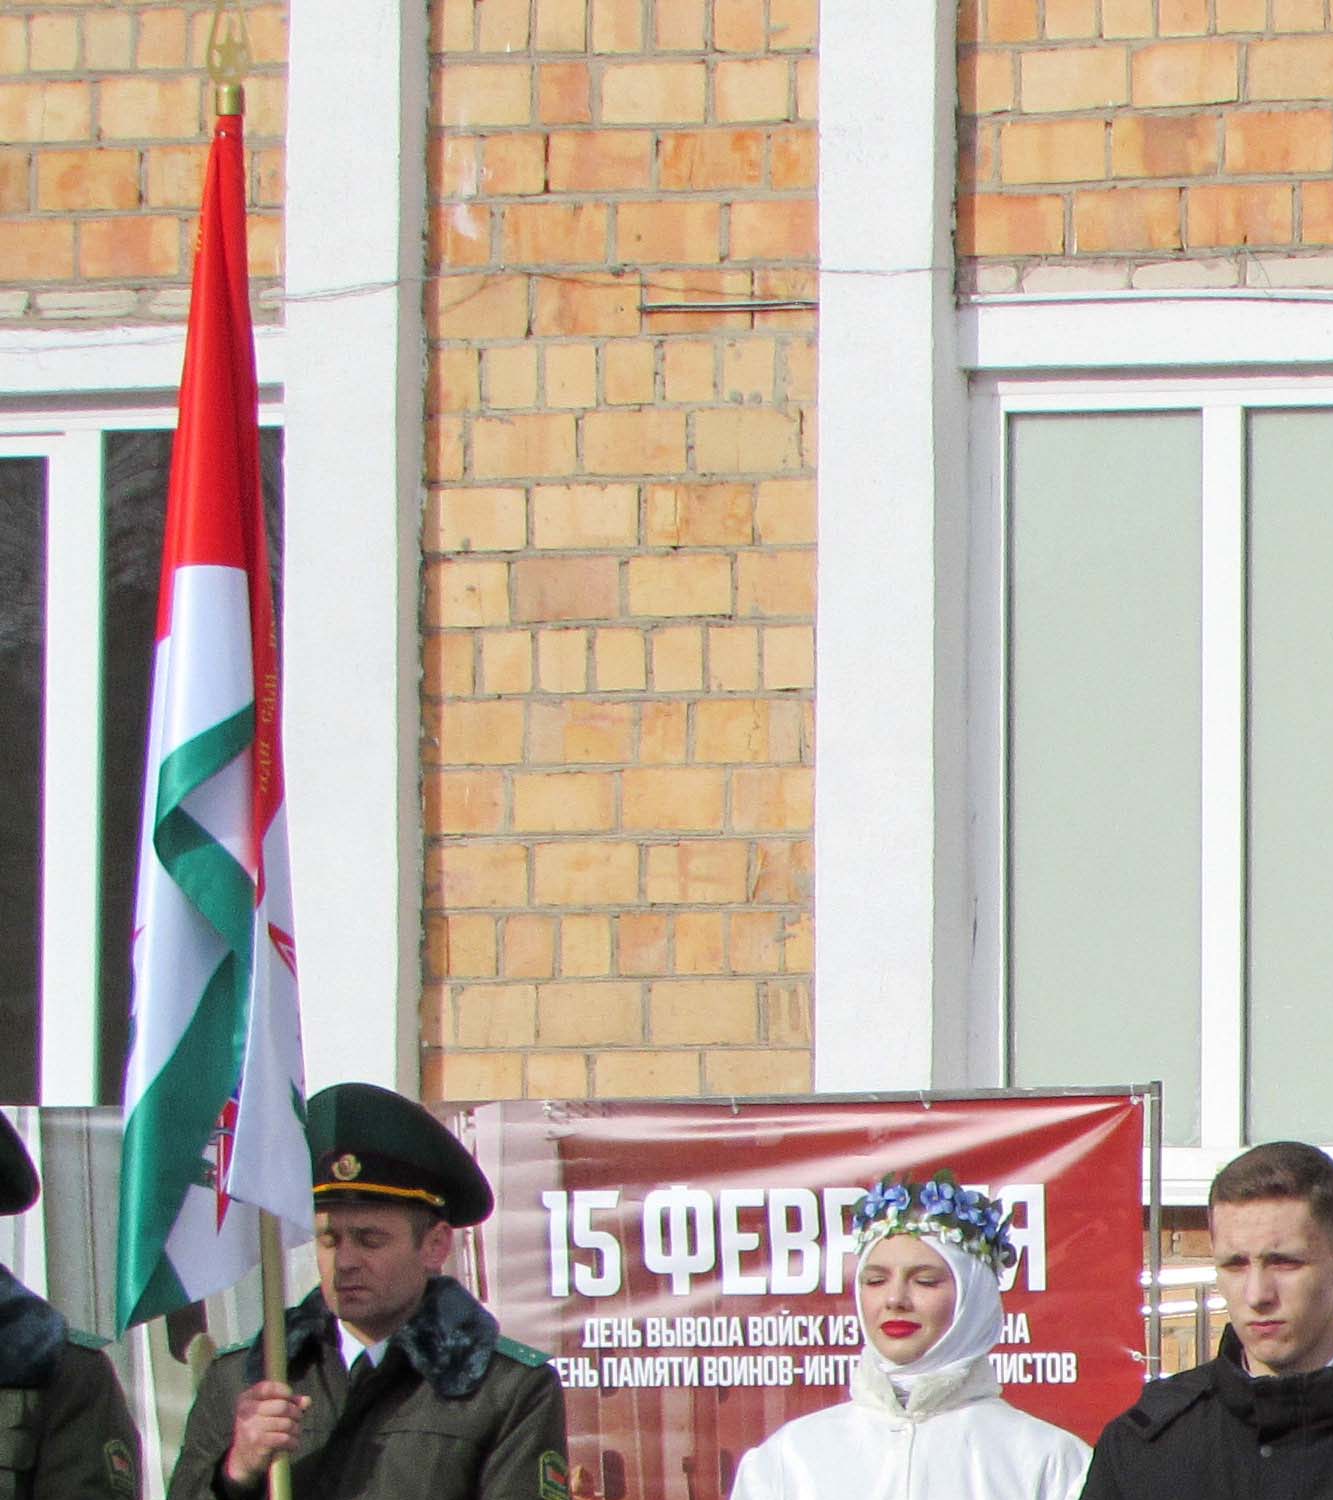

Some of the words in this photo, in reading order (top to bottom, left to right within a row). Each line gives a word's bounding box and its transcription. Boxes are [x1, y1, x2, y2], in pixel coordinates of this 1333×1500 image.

[542, 1188, 622, 1297] 15
[643, 1184, 1047, 1296] ФЕВРЯ
[582, 1316, 642, 1348] ДЕНЬ
[646, 1315, 743, 1347] ВЫВОДА
[748, 1308, 825, 1346] ВОЙСК
[828, 1316, 860, 1345] ИЗ
[603, 1356, 699, 1387] ПАМЯТИ
